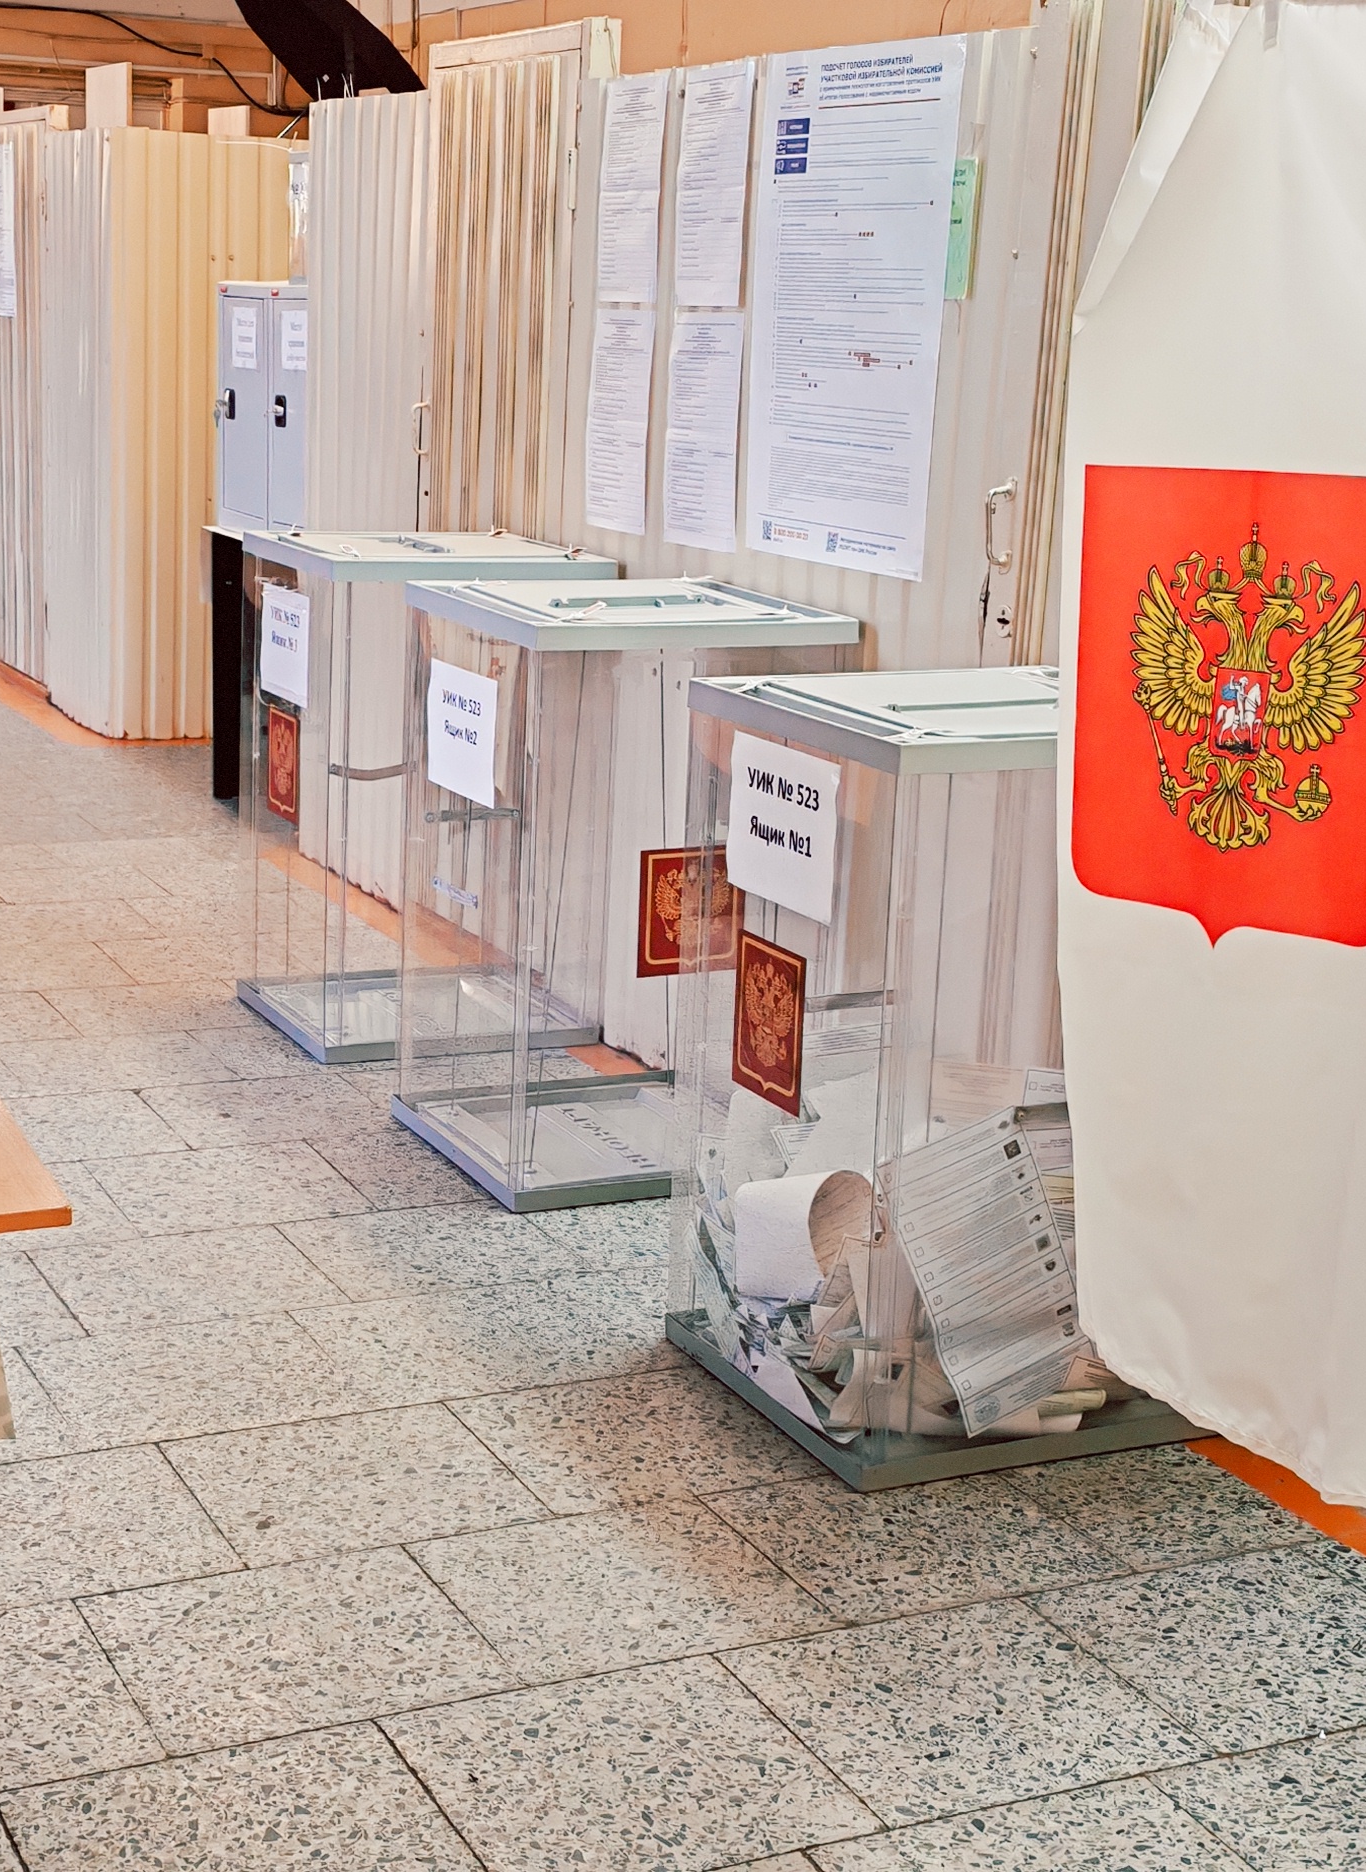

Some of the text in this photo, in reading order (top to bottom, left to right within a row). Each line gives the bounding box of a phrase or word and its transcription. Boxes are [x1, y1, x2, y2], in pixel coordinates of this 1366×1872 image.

[906, 62, 943, 75] КОМИССИЕЙ
[442, 689, 482, 717] УИК № 523
[444, 719, 477, 745] Ящик №2
[747, 766, 820, 812] УИК № 523
[749, 815, 812, 858] Ящик №1
